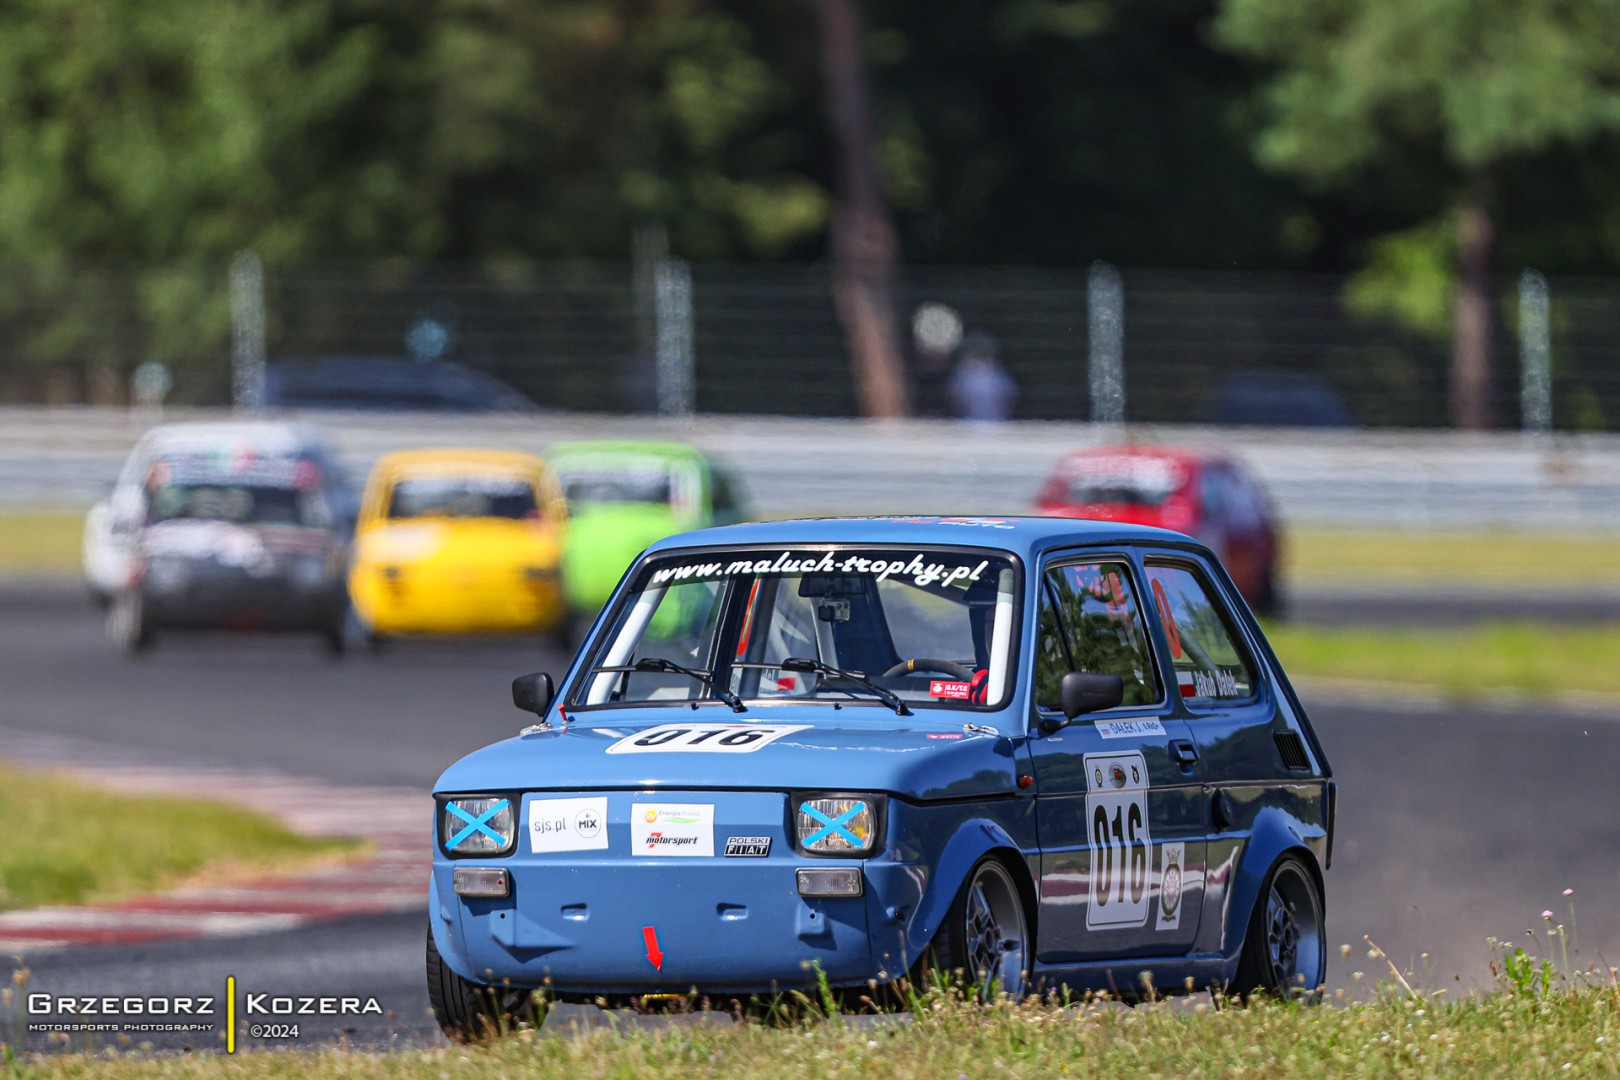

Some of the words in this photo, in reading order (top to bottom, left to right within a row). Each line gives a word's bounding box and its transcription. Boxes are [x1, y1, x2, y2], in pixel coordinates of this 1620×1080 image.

[652, 551, 989, 587] www.maluch-trophy.pl
[634, 729, 775, 746] 016
[534, 817, 567, 834] sjs.pl
[578, 819, 597, 828] MIX
[727, 845, 766, 854] FIAT
[1094, 802, 1146, 907] 016
